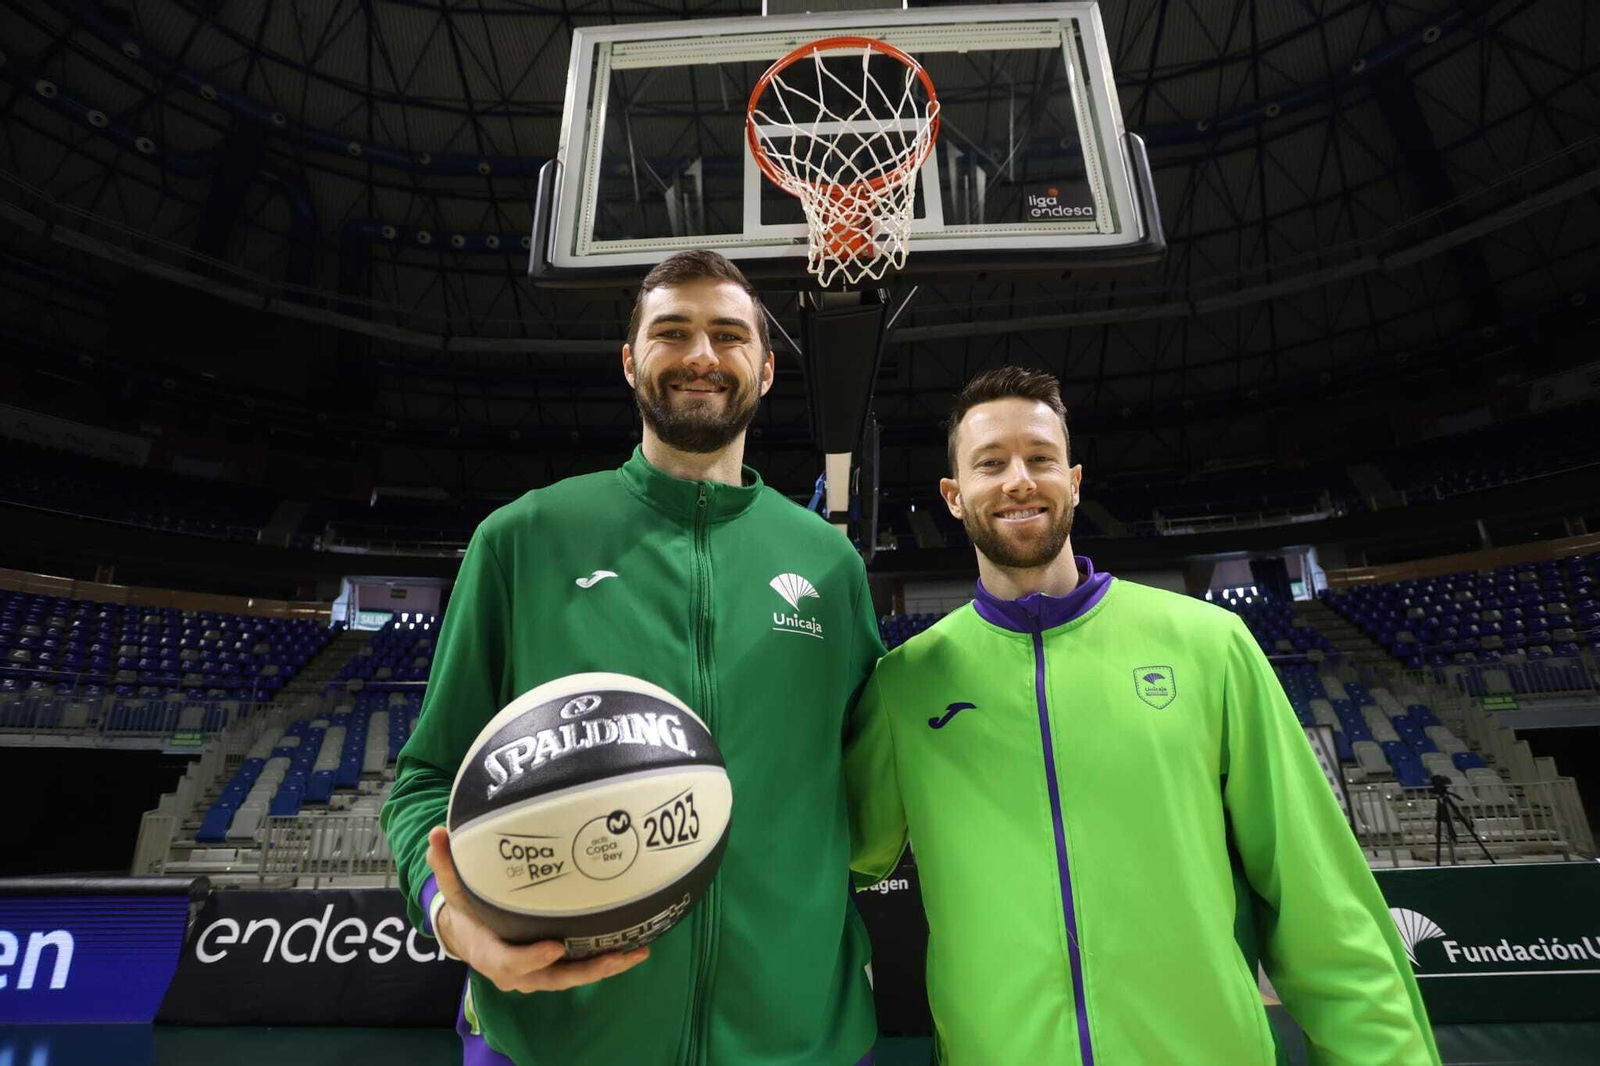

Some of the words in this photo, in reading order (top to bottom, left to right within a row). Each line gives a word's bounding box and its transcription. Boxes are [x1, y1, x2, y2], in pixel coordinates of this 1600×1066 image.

[1028, 194, 1057, 207] liga
[1031, 205, 1094, 217] endesa
[773, 611, 823, 634] Unicaja
[484, 713, 696, 800] SPALDING
[643, 792, 700, 848] 2023
[499, 838, 554, 863] Copa
[586, 841, 617, 856] Copa
[603, 850, 623, 862] Rey
[528, 860, 565, 881] Rey
[195, 903, 447, 964] endesa
